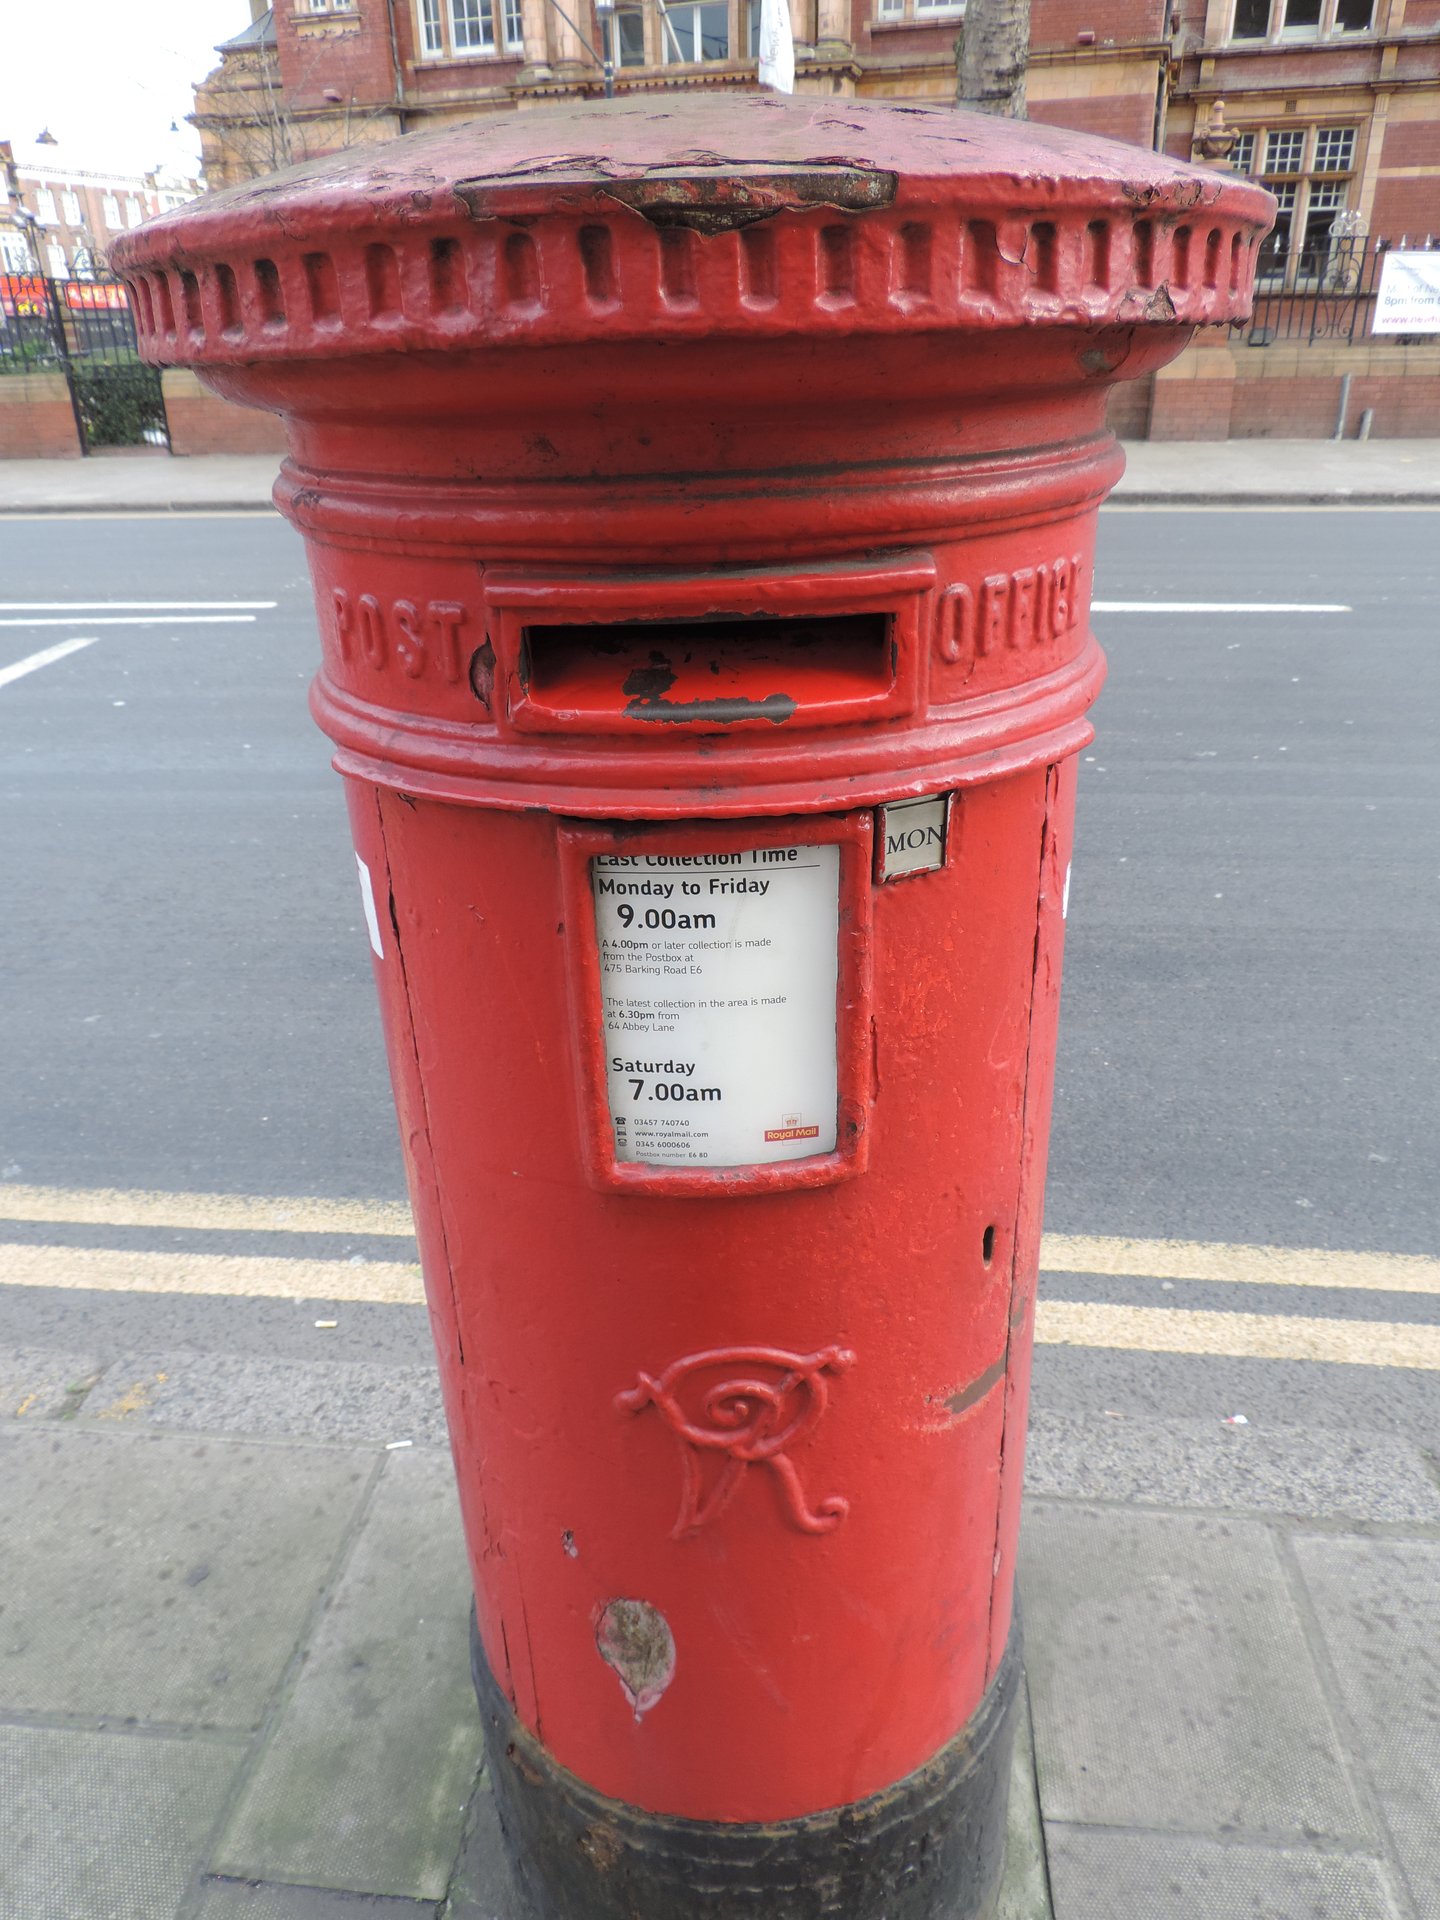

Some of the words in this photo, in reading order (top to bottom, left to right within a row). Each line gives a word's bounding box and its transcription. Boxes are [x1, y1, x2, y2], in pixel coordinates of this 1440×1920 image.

[1384, 296, 1408, 307] 8pm
[1410, 296, 1435, 305] from
[939, 554, 1081, 662] OFFICE
[332, 587, 466, 685] POST
[886, 823, 944, 855] MON
[645, 853, 742, 867] Collection
[752, 848, 798, 864] Time
[599, 878, 674, 899] Monday
[681, 880, 701, 895] to
[709, 877, 770, 896] Friday
[616, 903, 716, 929] 9.00am
[601, 940, 609, 948] A
[611, 940, 649, 950] 4.00pm
[664, 940, 685, 950] later
[688, 940, 730, 950] collection
[734, 939, 743, 948] is
[745, 938, 772, 948] made
[602, 951, 625, 961] from
[627, 952, 643, 961] the
[645, 952, 682, 962] Postbox
[684, 953, 695, 962] at
[604, 964, 622, 973] 475
[625, 964, 661, 976] Barking
[664, 965, 687, 975] Road
[690, 965, 703, 975] E6
[606, 997, 624, 1007] The
[626, 997, 651, 1008] latest
[653, 998, 696, 1009] collection
[698, 999, 707, 1009] in
[709, 999, 725, 1008] the
[750, 997, 759, 1006] is
[760, 995, 787, 1005] made
[607, 1010, 617, 1018] at
[618, 1010, 655, 1021] 6.30pm
[657, 1011, 680, 1020] from
[608, 1021, 620, 1030] 64
[622, 1022, 650, 1032] Abbey
[652, 1023, 675, 1032] Lane
[612, 1057, 696, 1077] Saturday
[628, 1078, 722, 1101] 7.00am
[634, 1118, 658, 1126] 03457
[661, 1119, 690, 1127] 740740
[634, 1130, 709, 1139] www.royalmail.com
[767, 1130, 794, 1140] Royal
[796, 1127, 817, 1137] Mail
[635, 1140, 655, 1148] 0345
[657, 1141, 691, 1149] 6000606
[635, 1150, 660, 1158] Postbox
